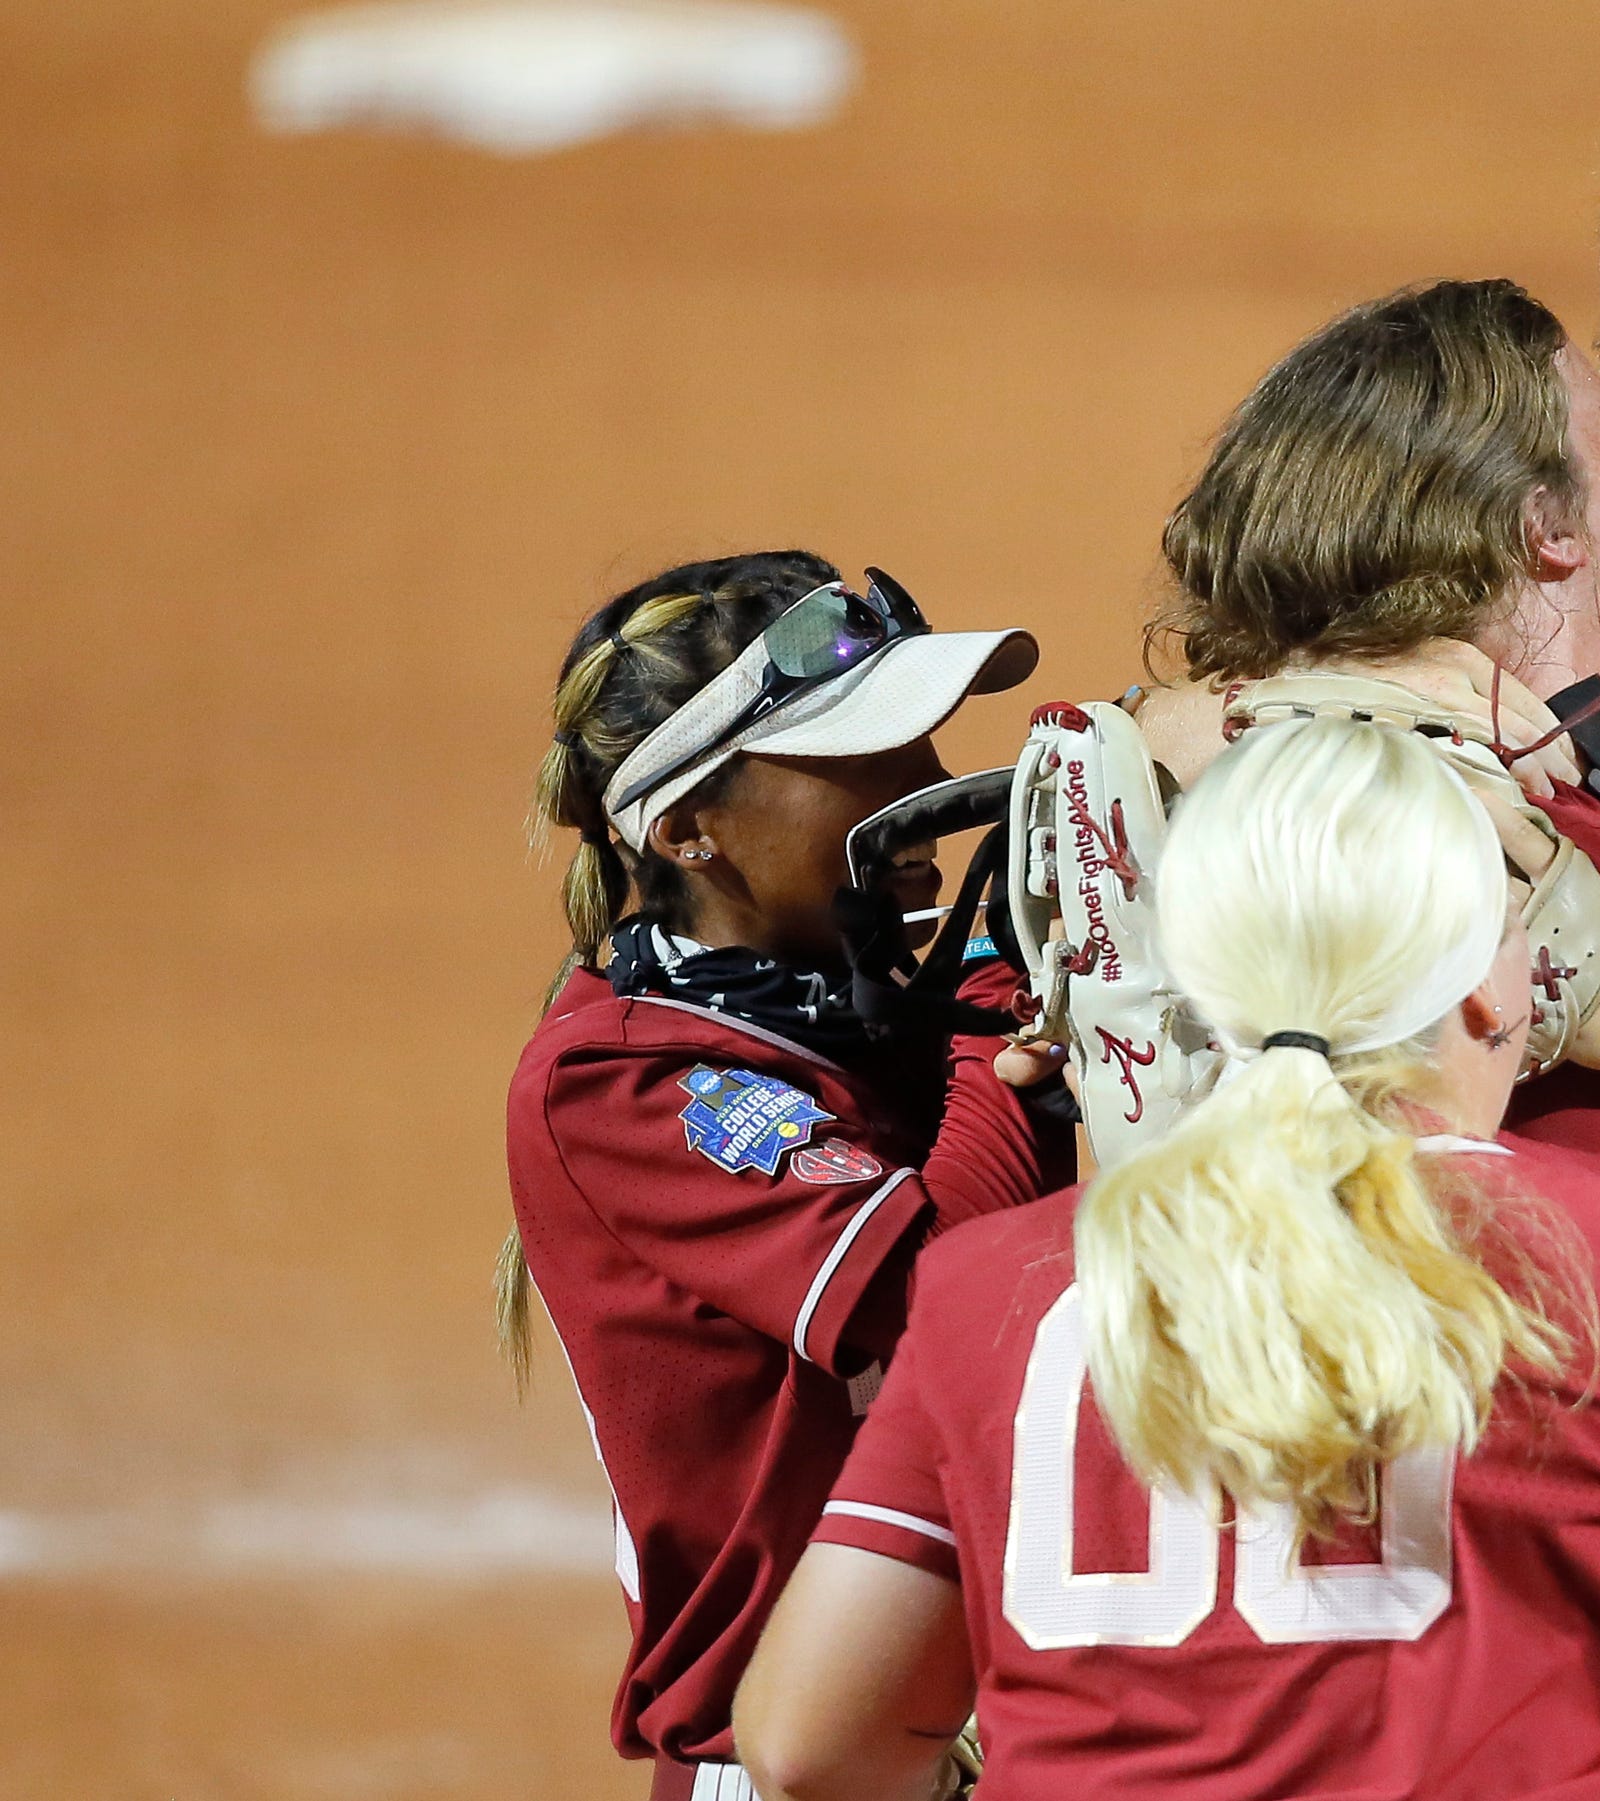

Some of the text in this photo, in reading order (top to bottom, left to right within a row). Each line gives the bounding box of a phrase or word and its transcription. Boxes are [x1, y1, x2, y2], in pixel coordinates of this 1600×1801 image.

[966, 941, 997, 954] TEAL
[699, 1074, 721, 1094] NCAA
[1095, 1025, 1155, 1123] A
[720, 1090, 804, 1164] WORLD SERIES
[722, 1087, 775, 1134] COLLEGE
[752, 1105, 799, 1149] OKLAHOMA CITY
